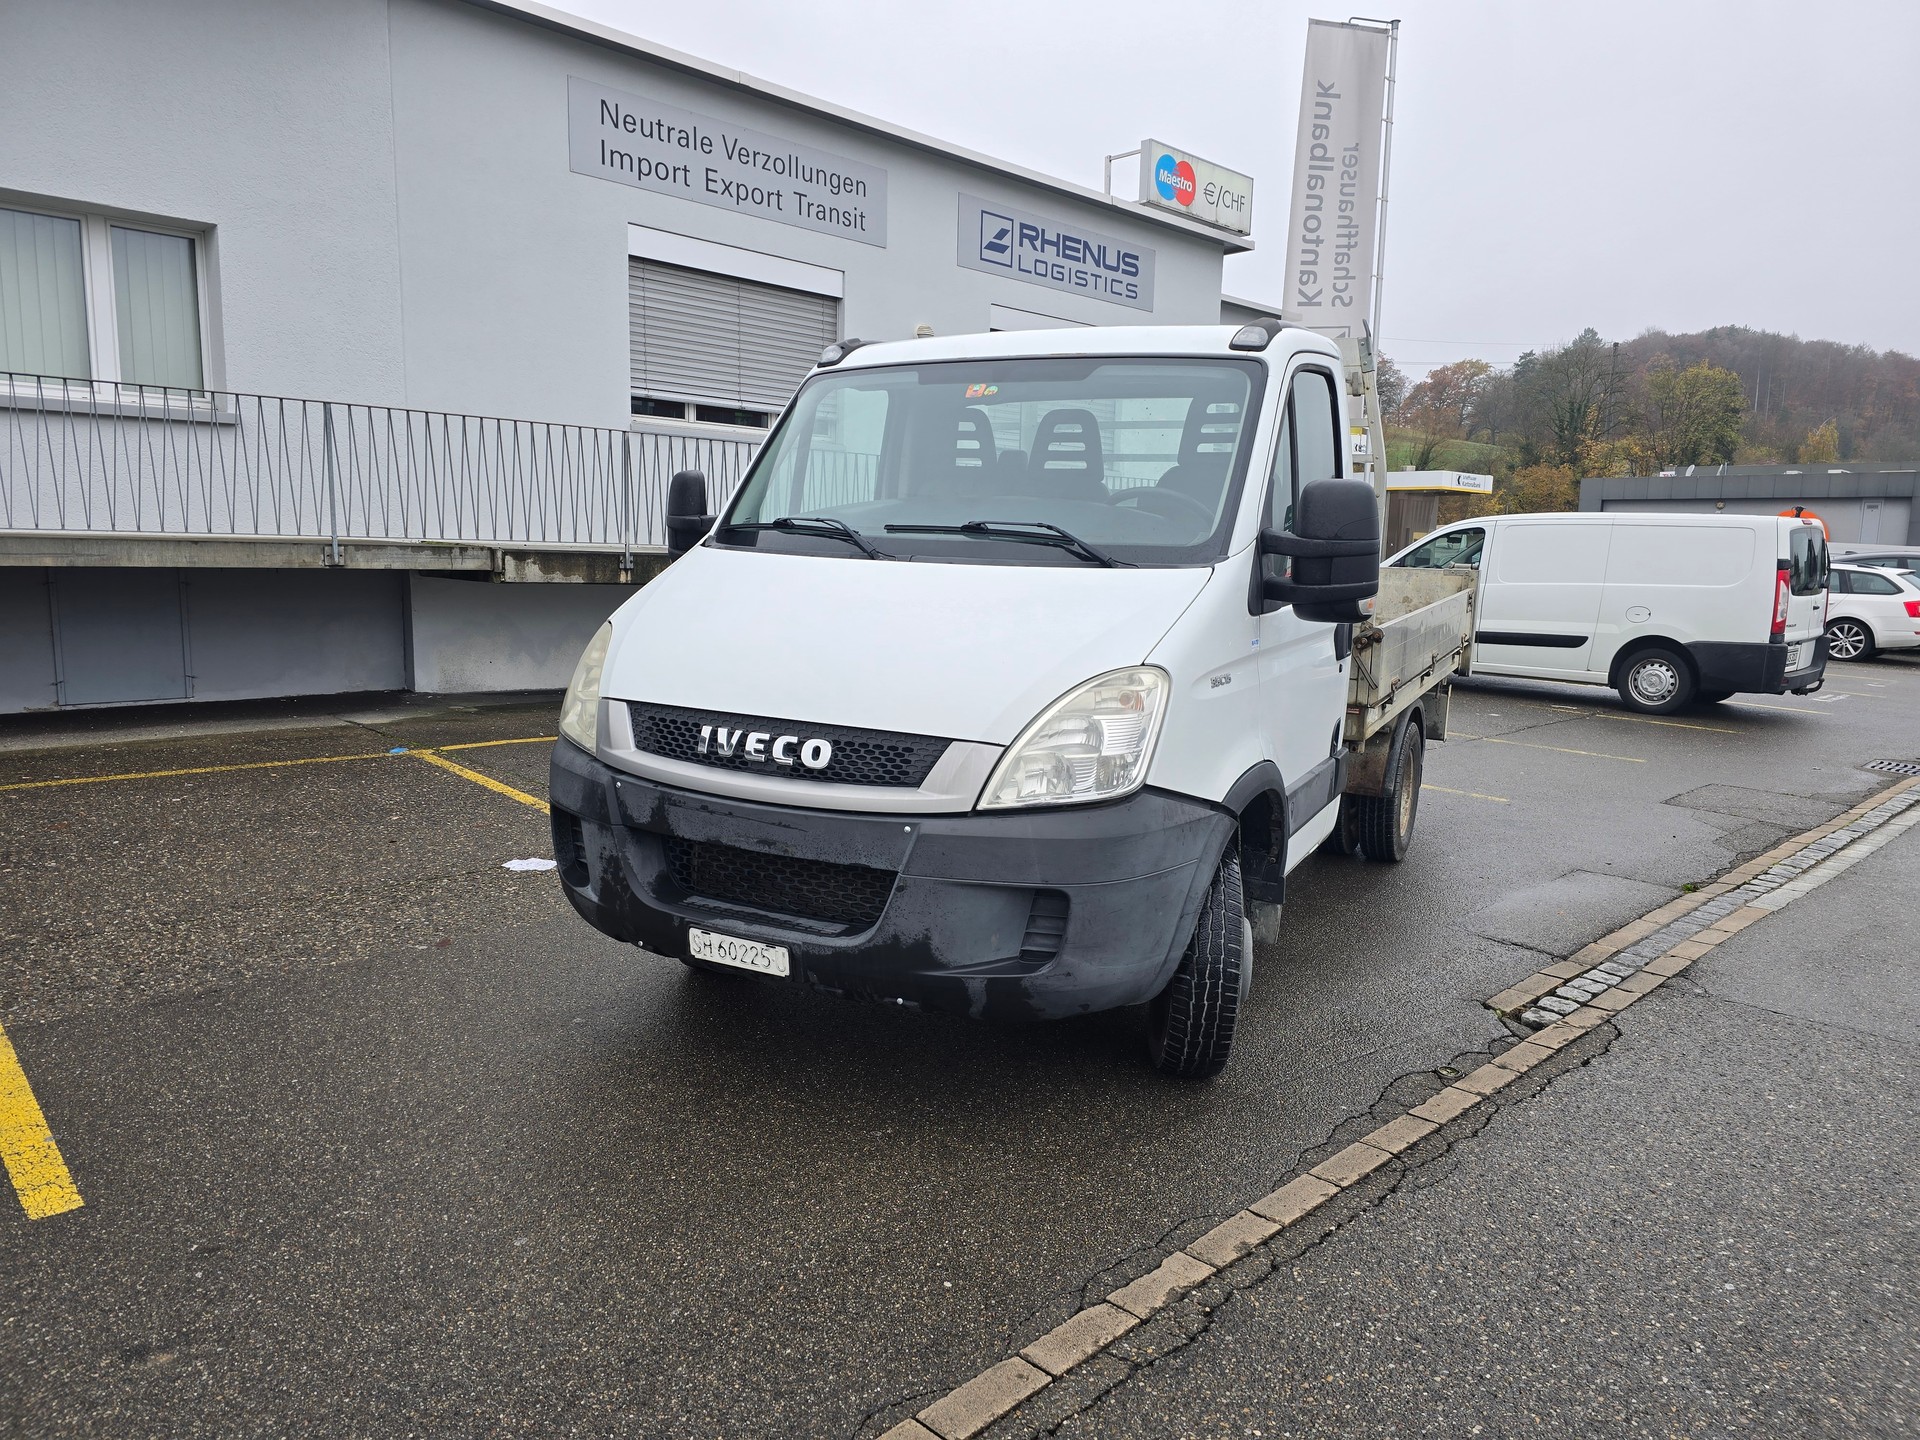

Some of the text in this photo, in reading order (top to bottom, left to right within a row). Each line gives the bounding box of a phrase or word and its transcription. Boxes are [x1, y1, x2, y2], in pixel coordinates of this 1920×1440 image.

[600, 98, 867, 197] Neutrale Verzollungen
[600, 139, 866, 232] Import Export Transit
[1158, 168, 1193, 193] Maestro
[1203, 181, 1245, 213] €/CHF
[1018, 221, 1140, 278] RHENUS
[1018, 254, 1138, 300] LOGISTICS
[697, 725, 833, 769] IVECO
[717, 940, 771, 969] 60225
